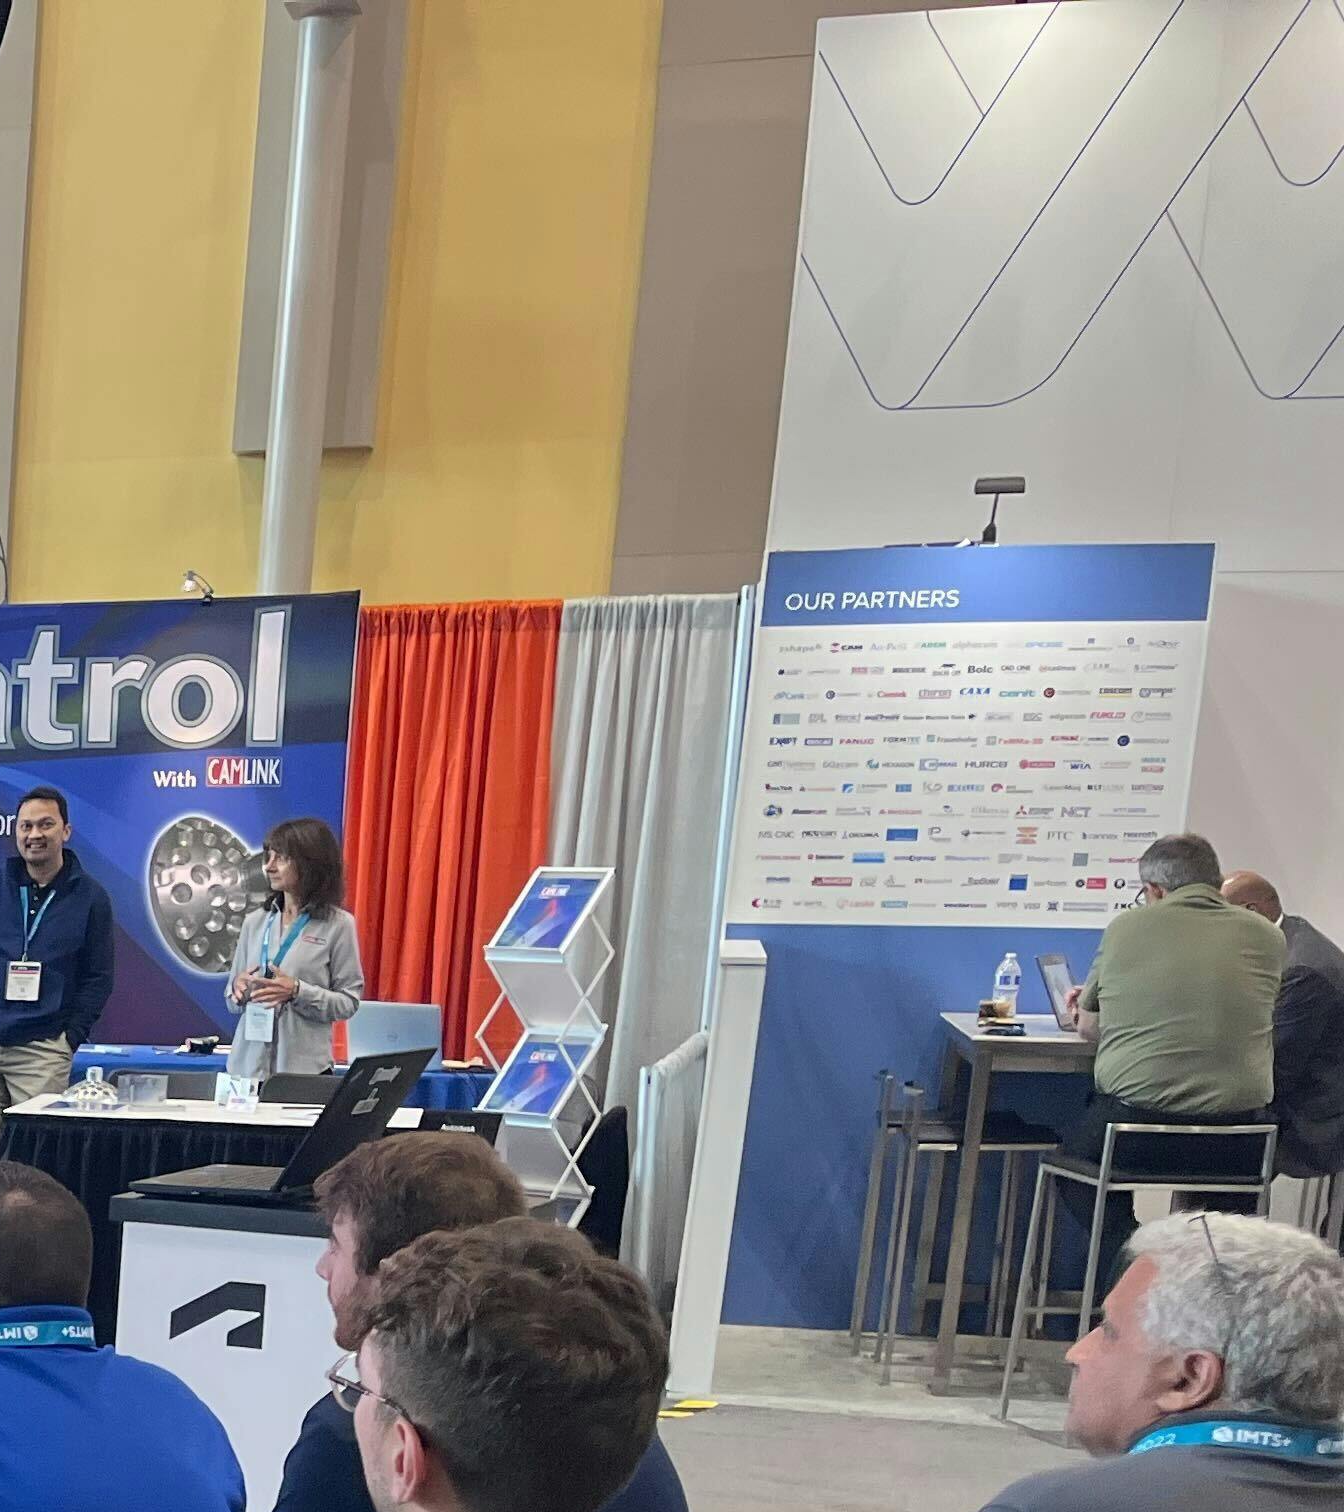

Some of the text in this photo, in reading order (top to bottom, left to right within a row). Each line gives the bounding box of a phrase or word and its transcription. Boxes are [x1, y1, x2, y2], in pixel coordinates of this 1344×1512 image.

[785, 589, 961, 611] OUR PARTNERS
[960, 687, 991, 695] CAXA
[839, 737, 876, 745] FANUC
[964, 760, 1009, 769] HURCO
[153, 758, 281, 788] With CAMLINK
[1061, 806, 1092, 818] NCT
[1047, 831, 1073, 840] PTC
